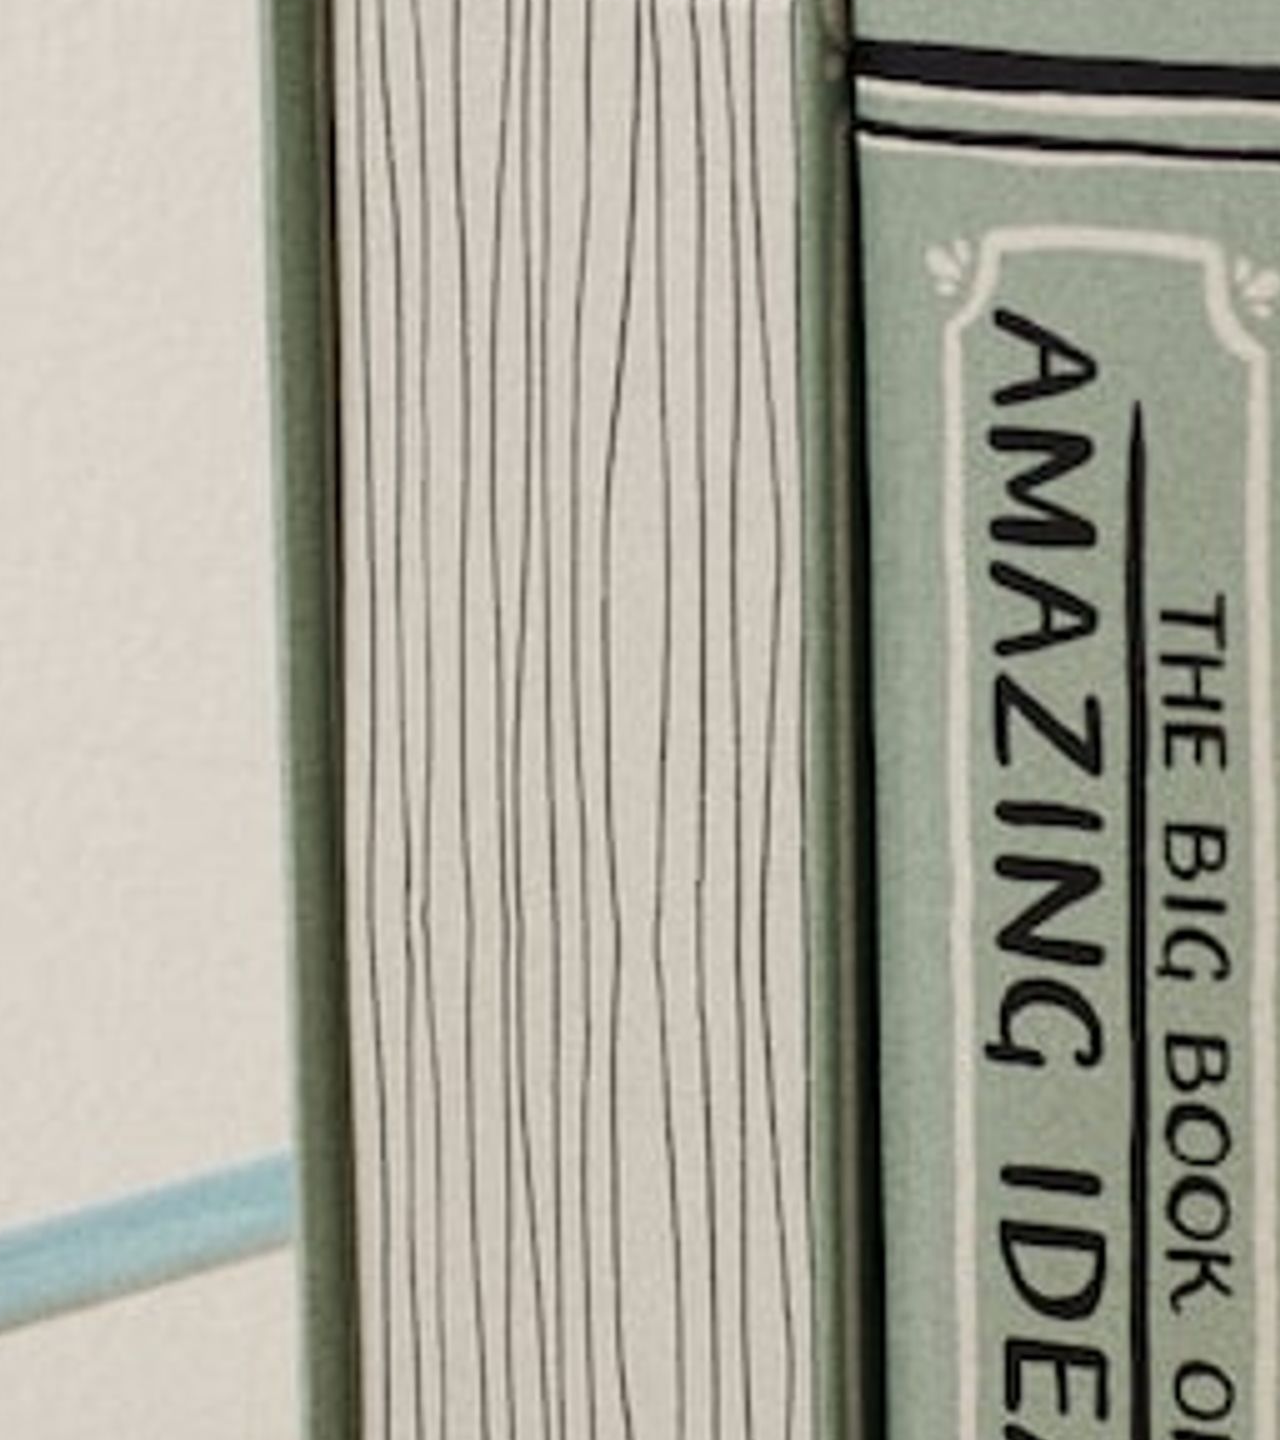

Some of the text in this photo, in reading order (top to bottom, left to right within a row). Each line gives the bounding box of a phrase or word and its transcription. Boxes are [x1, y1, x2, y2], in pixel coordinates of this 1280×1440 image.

[983, 307, 1107, 1070] AMAZING
[1158, 593, 1228, 772] THE
[1155, 822, 1231, 983] BIG
[1163, 1031, 1233, 1316] BOOK
